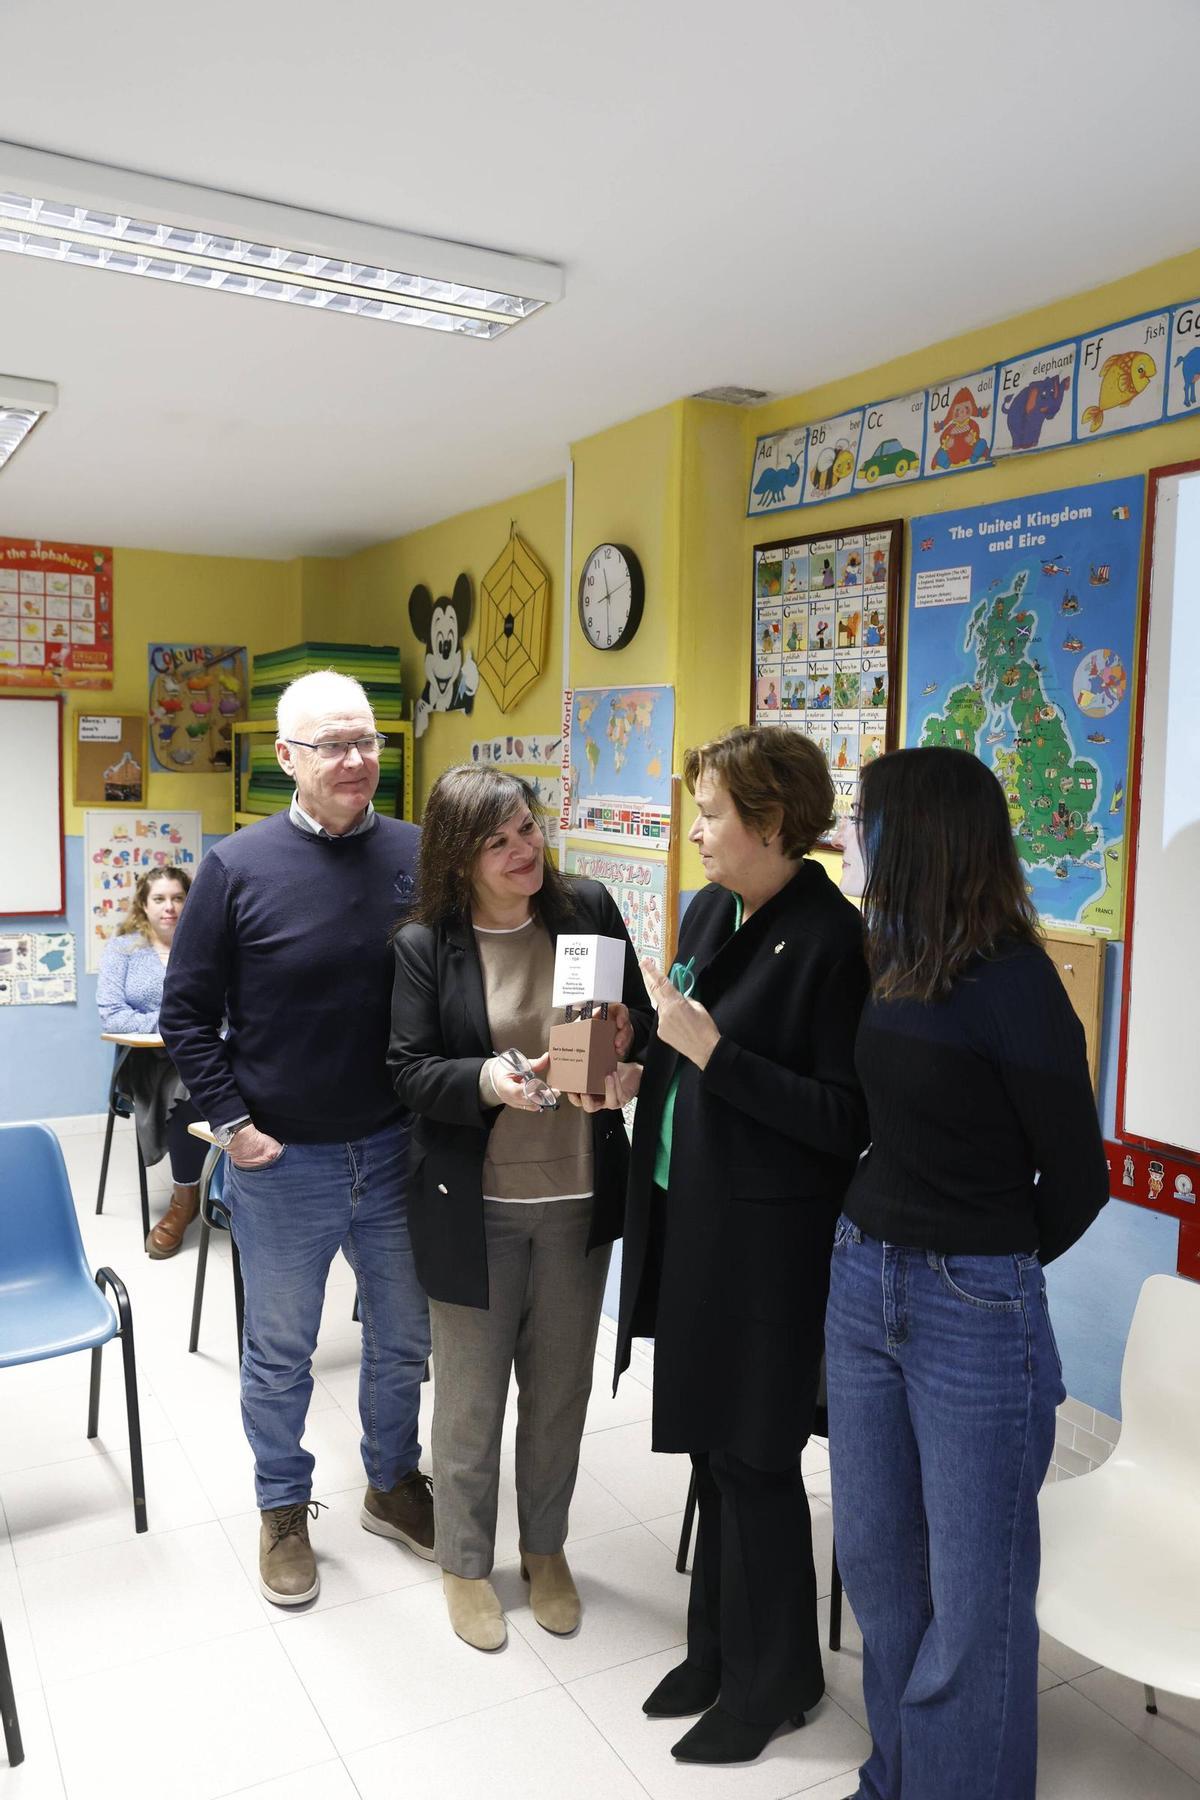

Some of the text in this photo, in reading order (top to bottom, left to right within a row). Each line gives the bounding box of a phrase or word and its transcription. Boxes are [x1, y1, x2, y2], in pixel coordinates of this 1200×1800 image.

[1144, 323, 1165, 344] fish
[1084, 339, 1103, 370] Ff
[1033, 354, 1073, 375] elephant
[977, 375, 992, 392] doll
[1003, 370, 1020, 390] Ee
[931, 387, 949, 411] Dd
[911, 402, 923, 412] car
[867, 412, 883, 429] Cc
[811, 426, 826, 446] Bb
[758, 445, 772, 459] Aa
[949, 505, 1092, 540] The United Kingdom
[989, 533, 1046, 552] and Eire
[7, 548, 26, 559] the
[604, 548, 611, 559] 12
[594, 560, 600, 569] 11
[587, 576, 594, 586] 10
[585, 597, 590, 606] 9
[588, 617, 593, 627] 8
[596, 631, 600, 641] 7
[606, 635, 612, 645] 6
[560, 690, 573, 830] Map of the World
[160, 823, 170, 835] c
[181, 848, 194, 863] h
[649, 895, 657, 911] 5
[1095, 907, 1113, 915] FRANCE
[564, 947, 589, 956] FECEI
